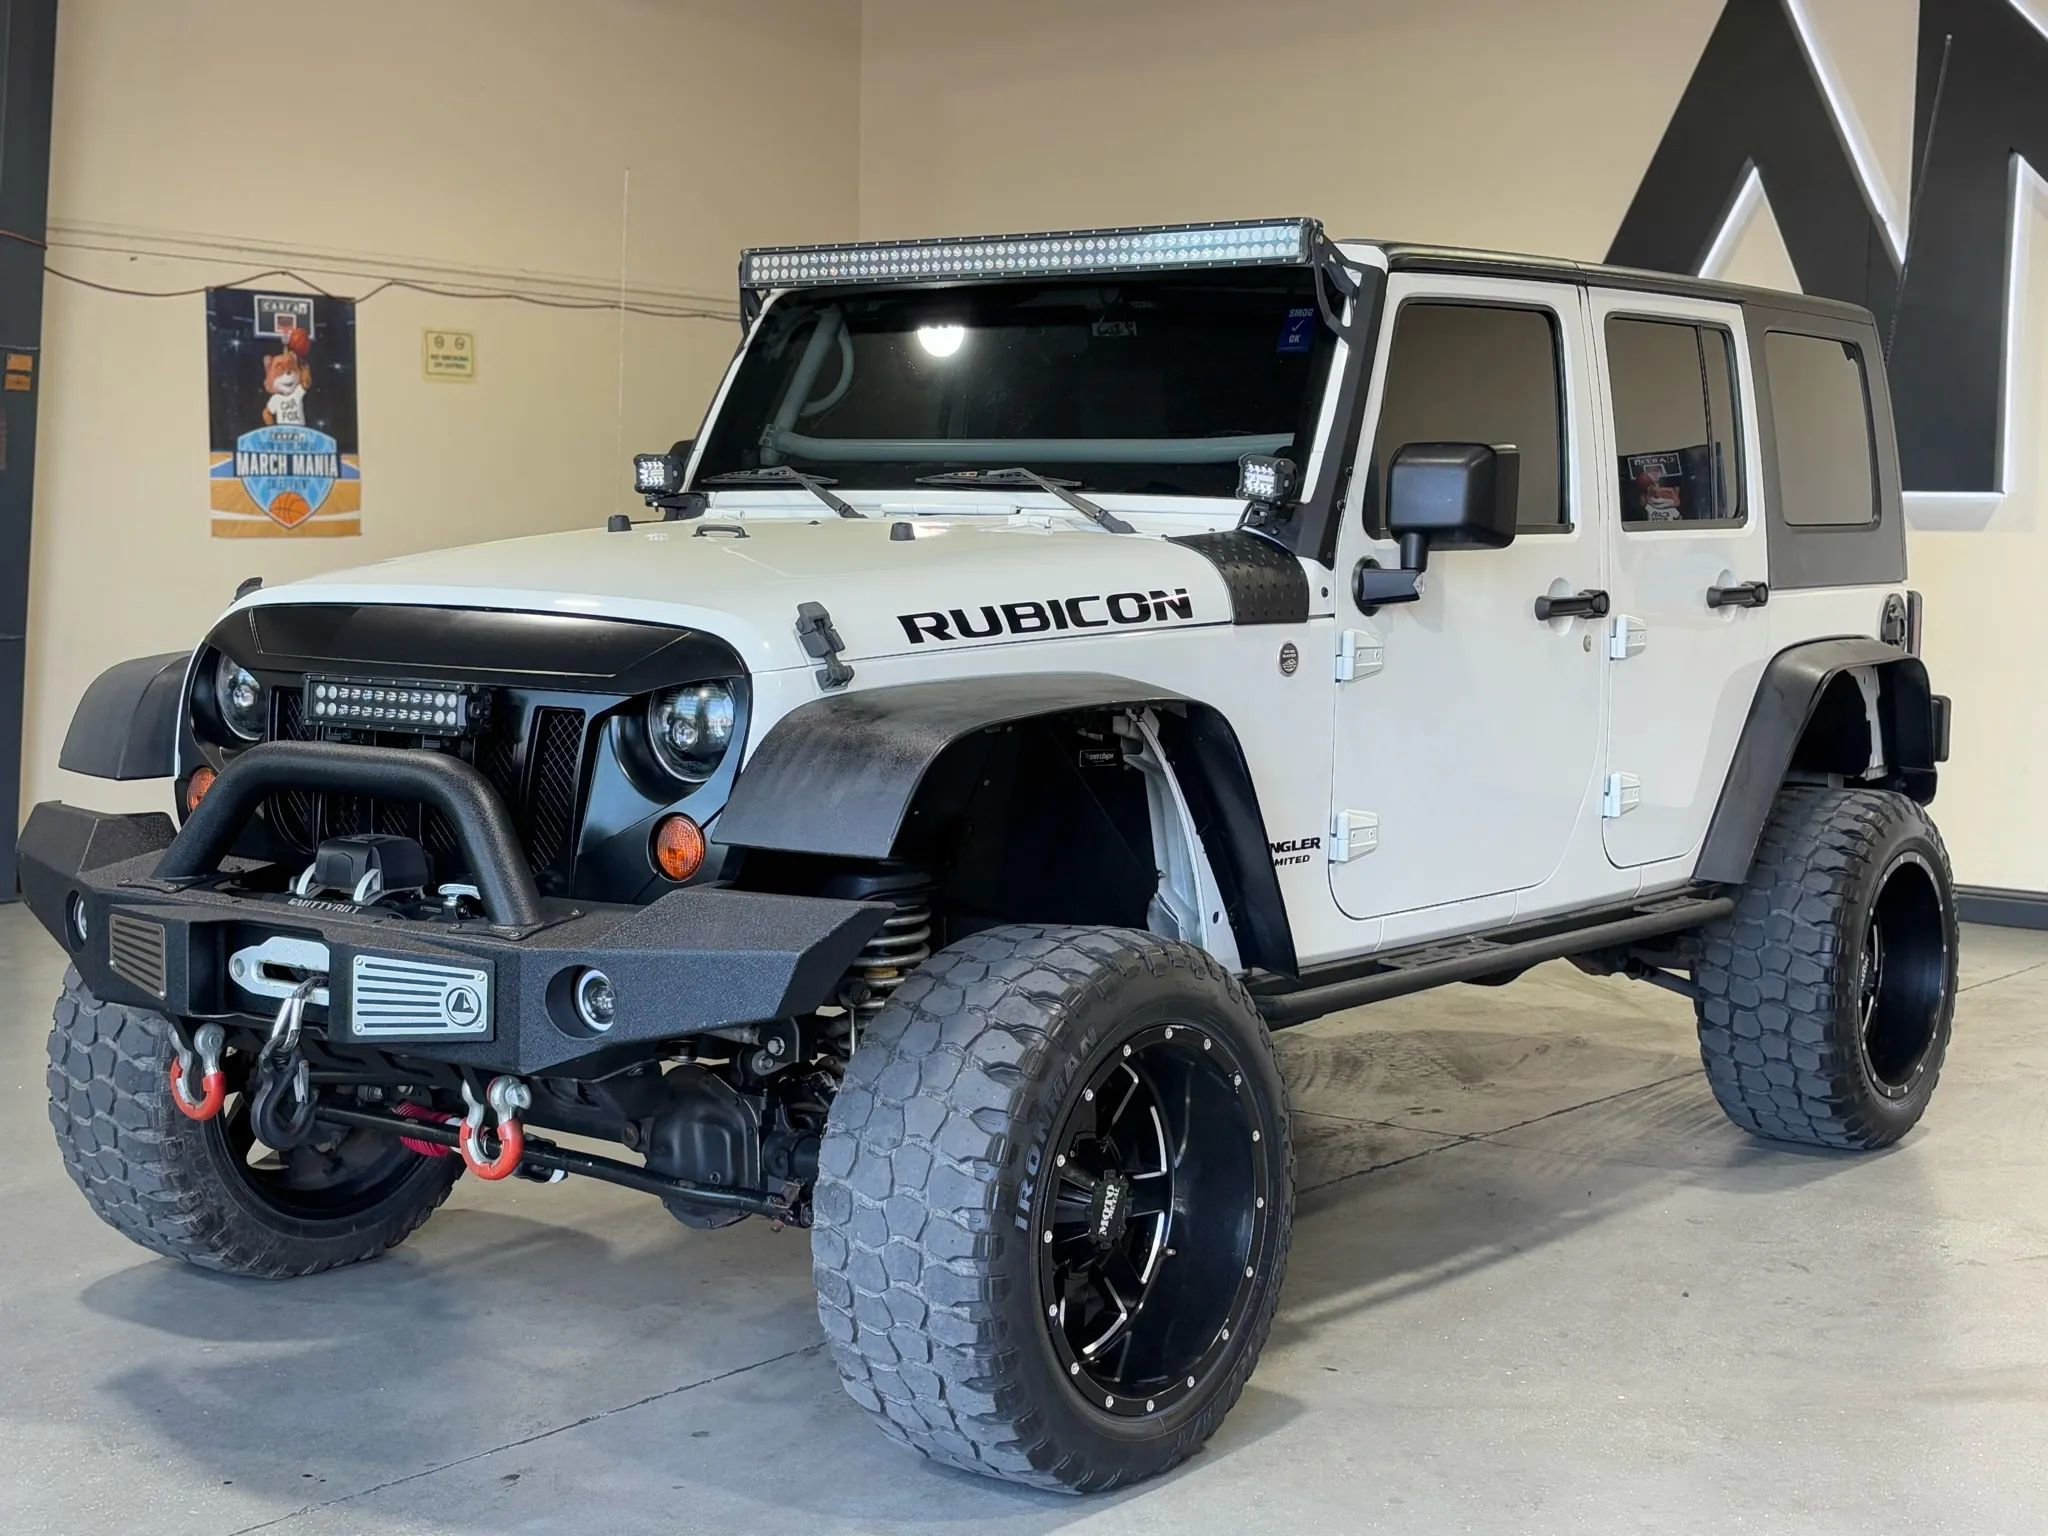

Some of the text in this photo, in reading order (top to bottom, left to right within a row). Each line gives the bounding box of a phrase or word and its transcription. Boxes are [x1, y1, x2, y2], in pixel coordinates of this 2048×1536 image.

[1288, 308, 1314, 318] SMOG
[236, 452, 339, 478] MARCH MANIA
[896, 587, 1194, 644] RUBICON
[1270, 836, 1321, 854] NGLER
[1274, 854, 1311, 867] MITED
[1098, 1184, 1115, 1237] MOTO
